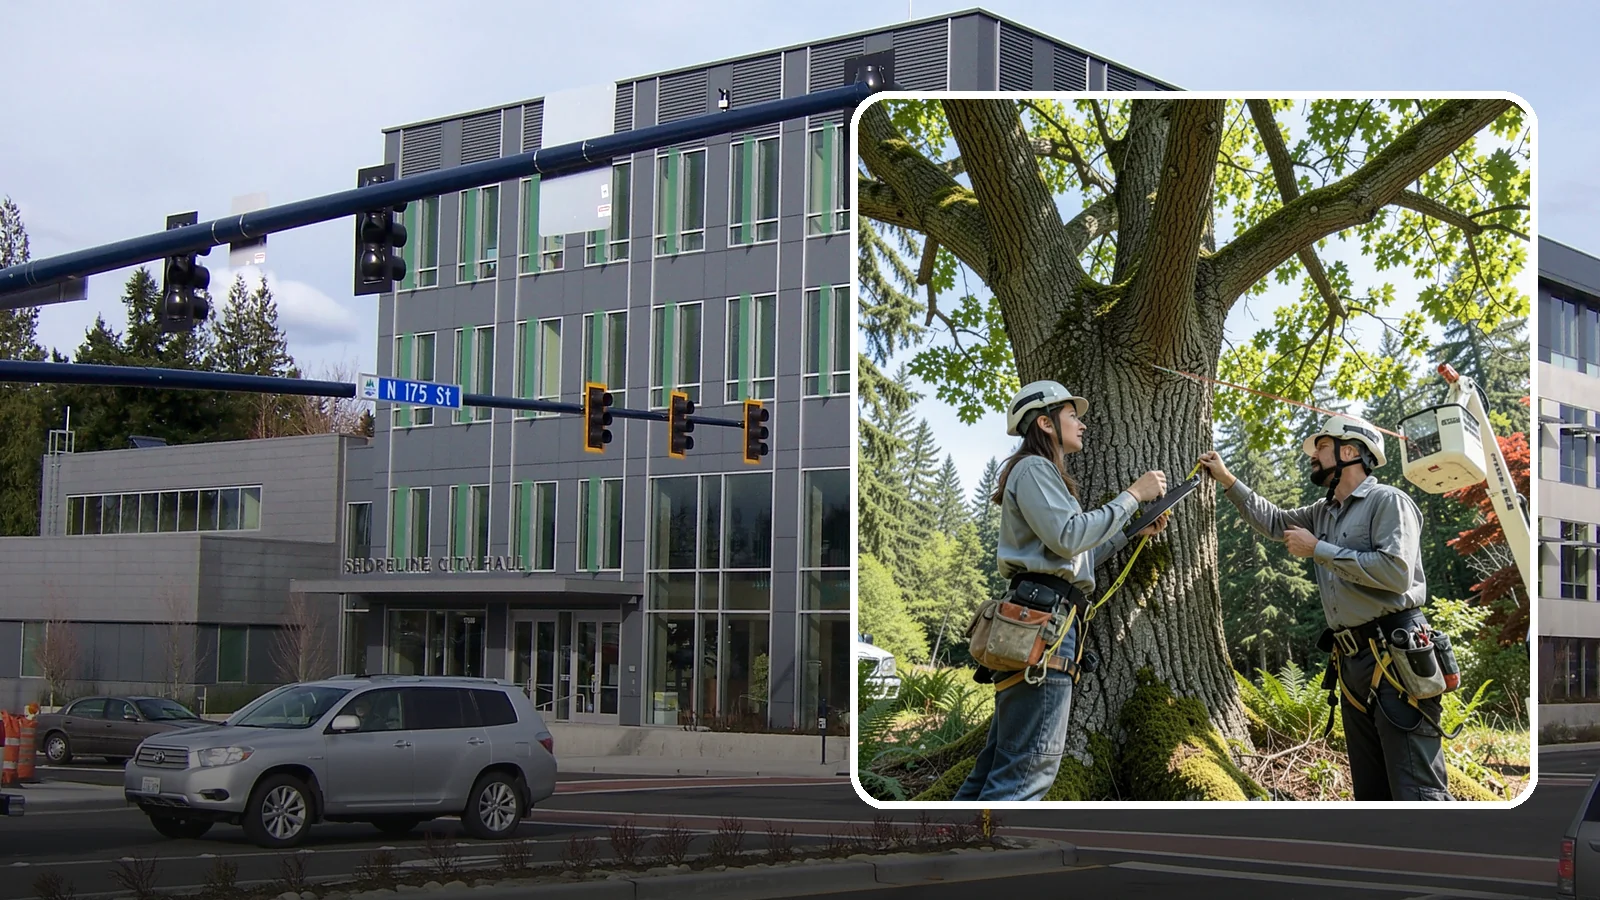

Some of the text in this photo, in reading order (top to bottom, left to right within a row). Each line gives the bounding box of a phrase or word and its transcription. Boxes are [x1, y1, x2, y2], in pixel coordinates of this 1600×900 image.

[387, 380, 451, 406] N 175 St
[344, 555, 526, 574] SHORELINE CITY HALL
